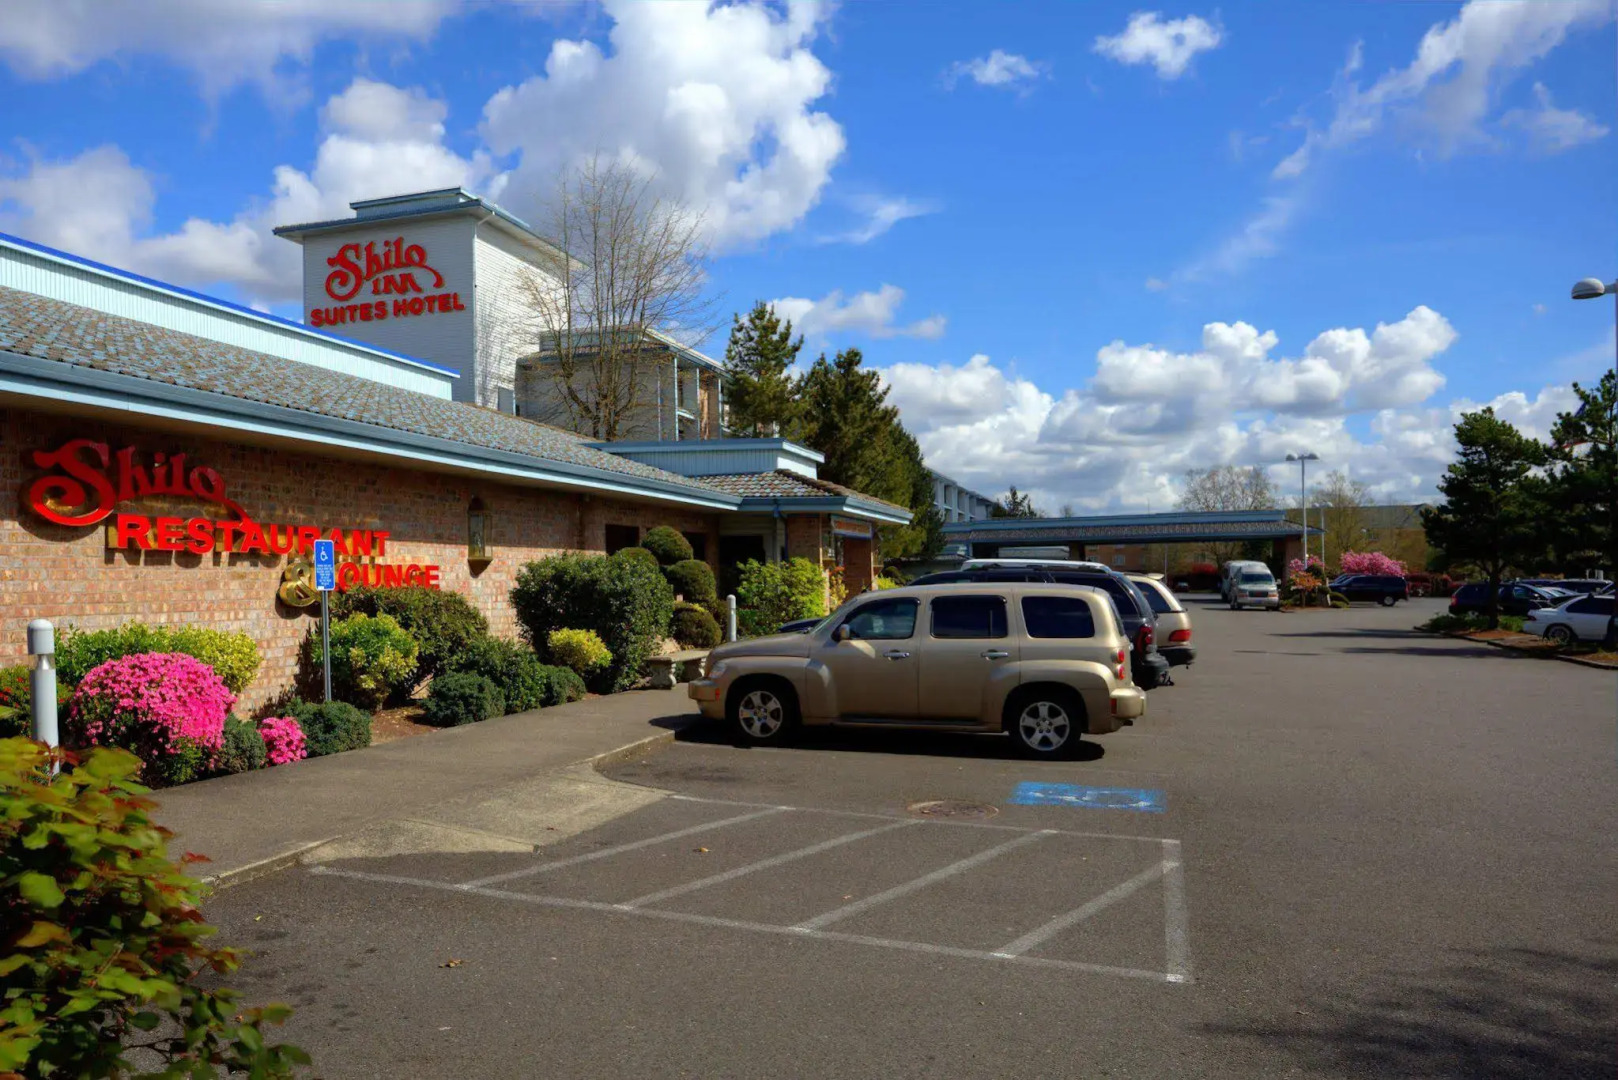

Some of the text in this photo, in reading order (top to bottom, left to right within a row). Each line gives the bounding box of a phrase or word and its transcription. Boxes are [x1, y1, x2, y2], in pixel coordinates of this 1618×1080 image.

[325, 236, 445, 301] Shilo
[371, 273, 423, 294] INN
[310, 293, 465, 327] SUITES HOTEL
[29, 438, 251, 527] Shilo
[117, 513, 391, 557] RESTAURANT
[333, 561, 440, 593] OUNGE
